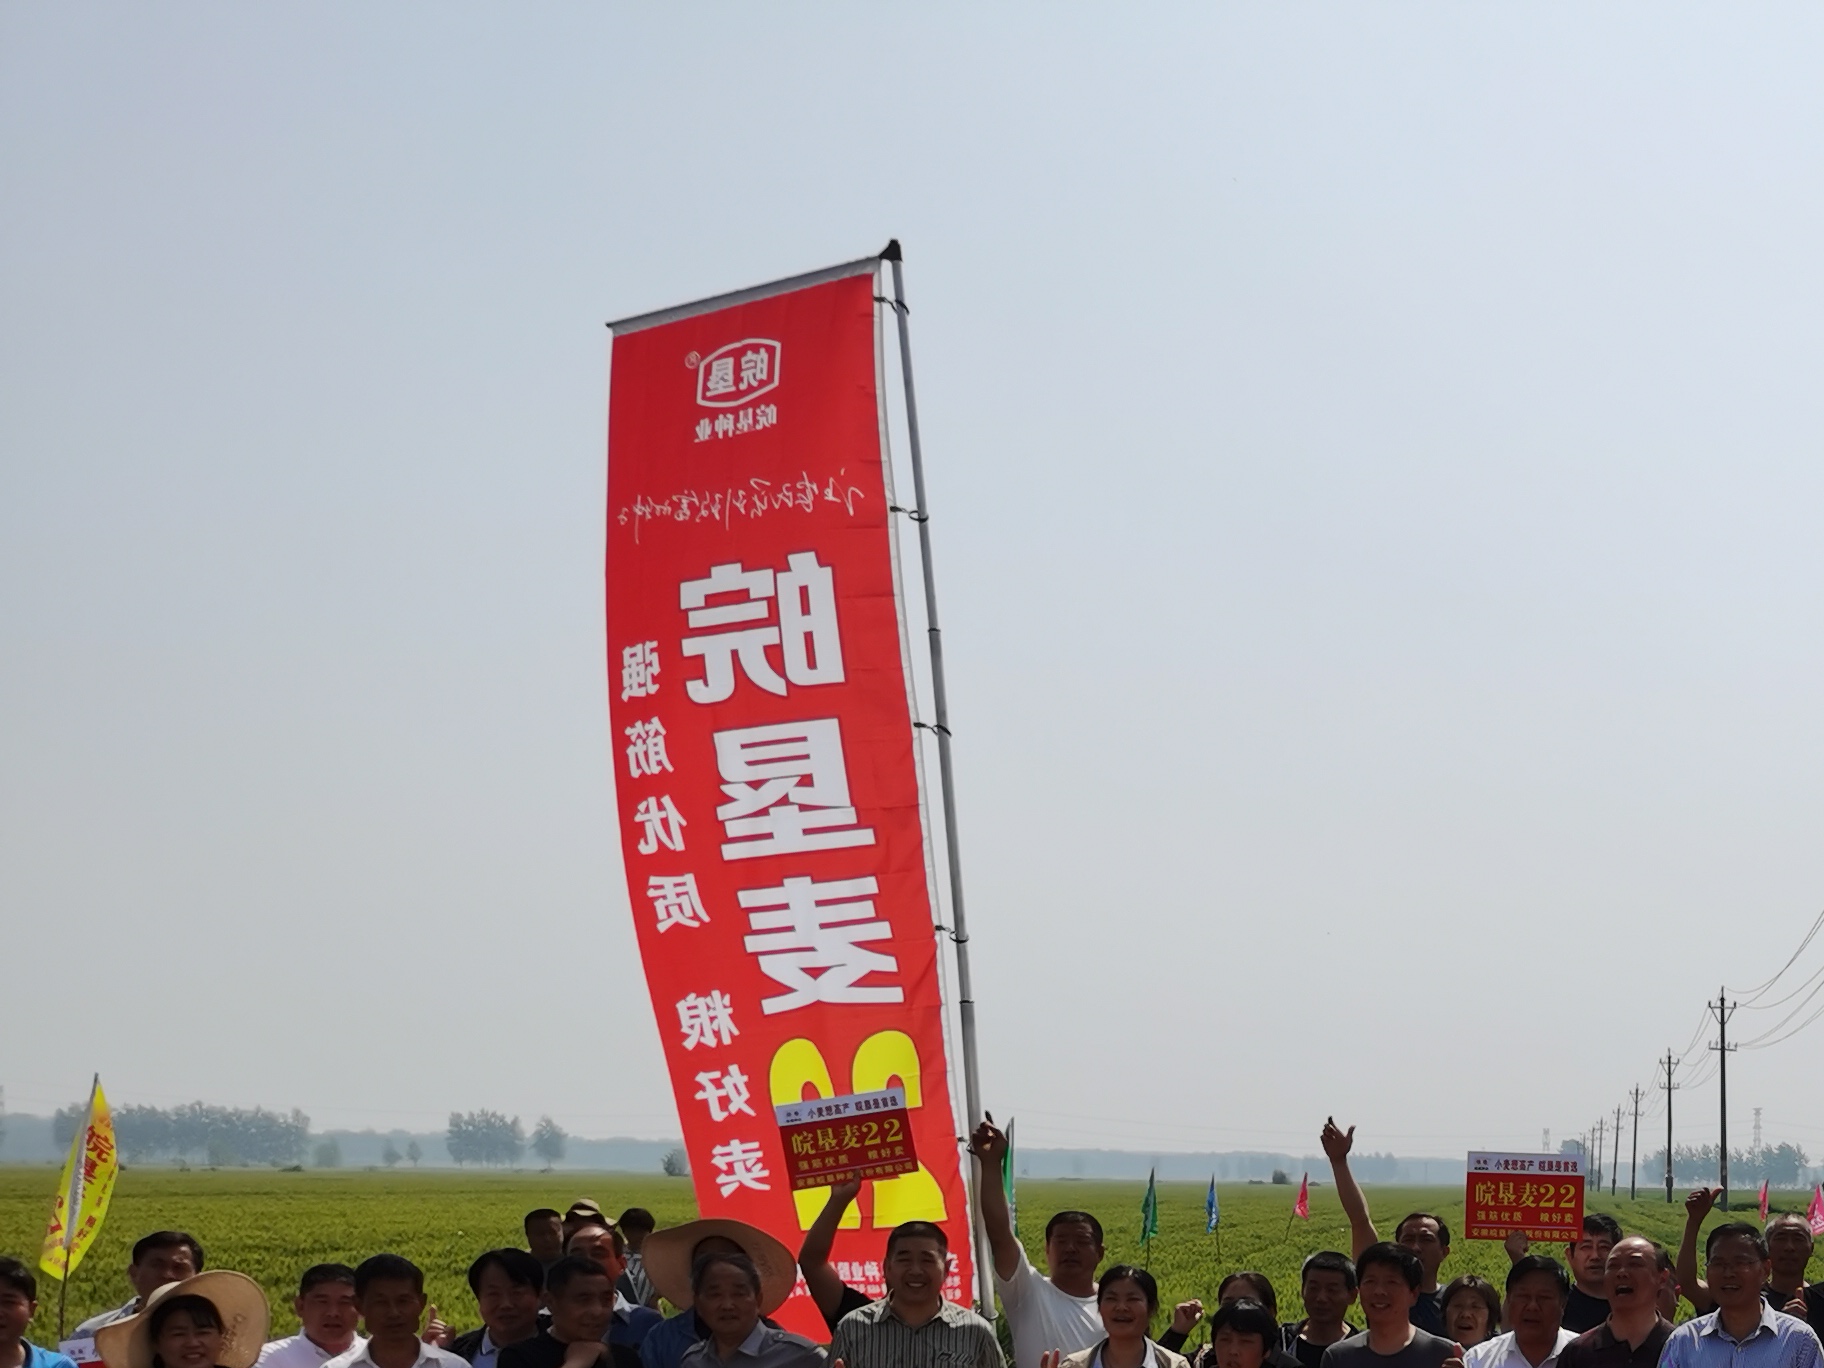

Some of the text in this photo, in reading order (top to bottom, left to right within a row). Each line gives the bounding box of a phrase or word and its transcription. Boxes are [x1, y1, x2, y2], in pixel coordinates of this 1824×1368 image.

[791, 1118, 904, 1156] 皖垦麦22
[1474, 1180, 1577, 1209] 皖垦麦22
